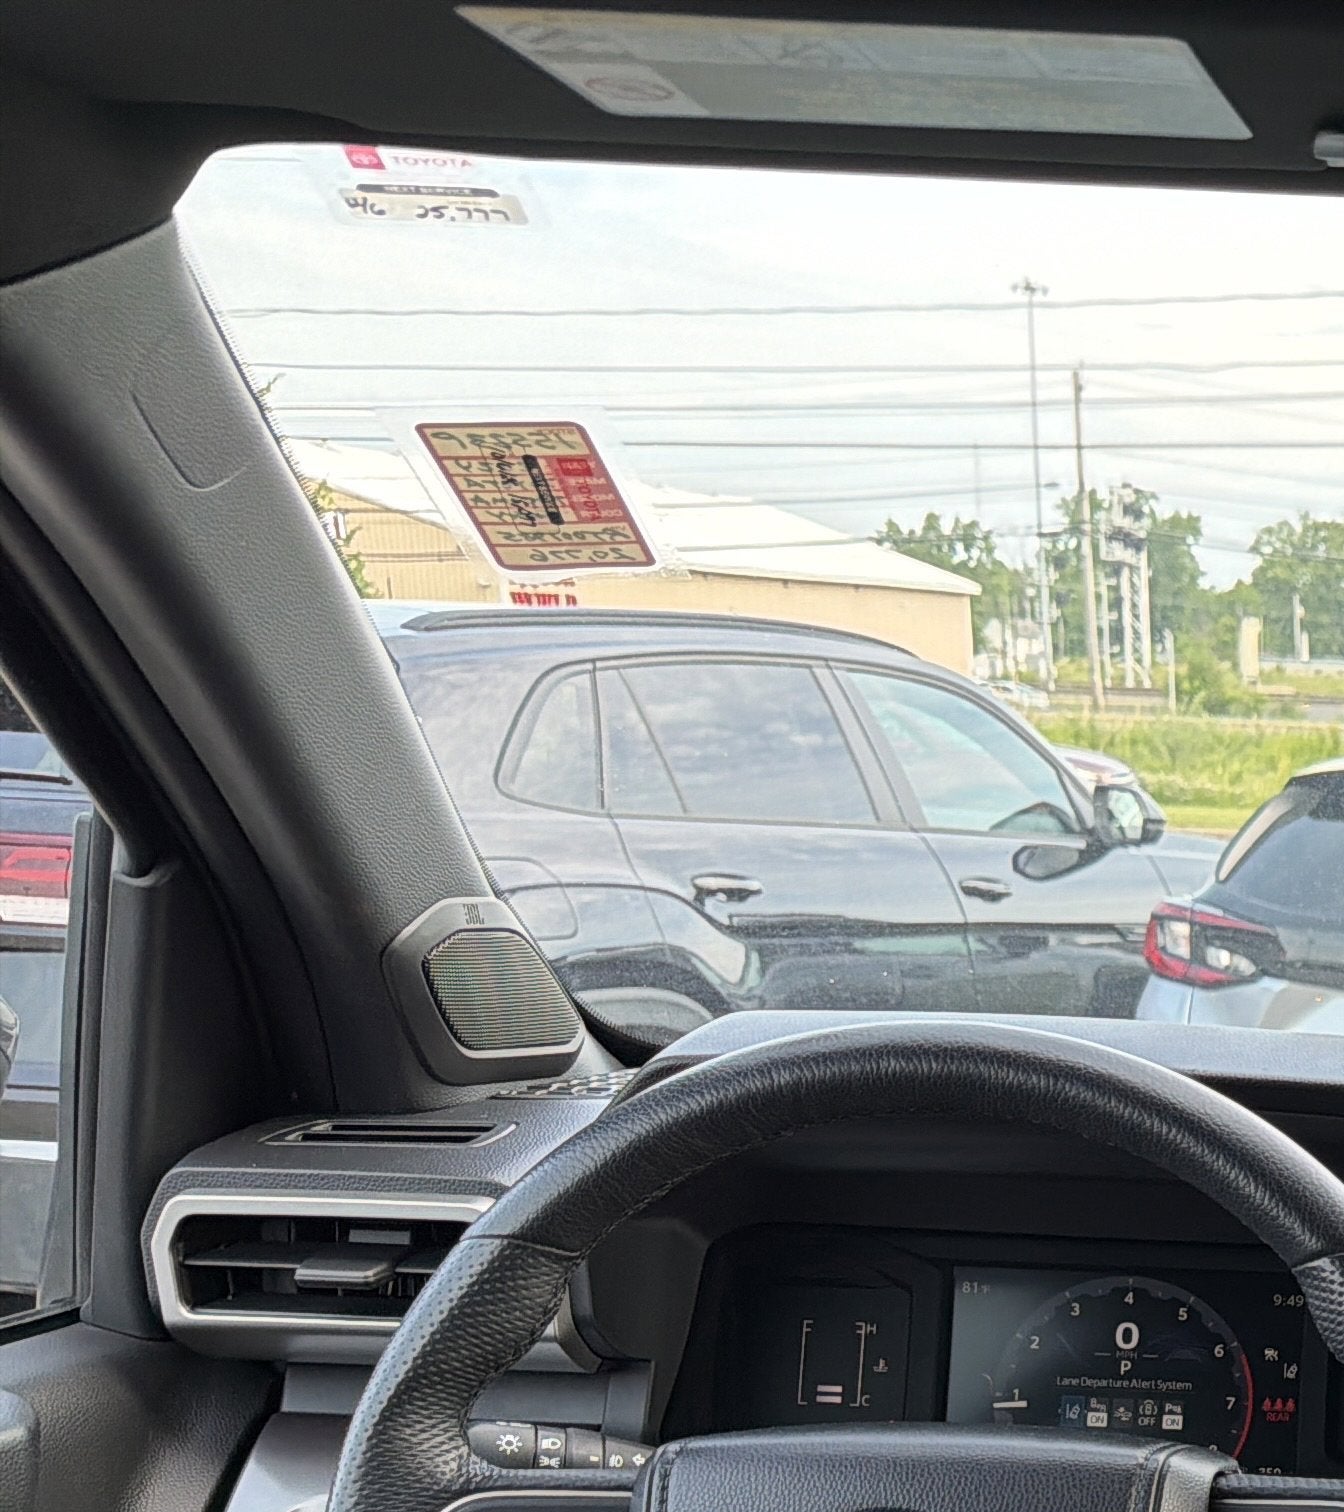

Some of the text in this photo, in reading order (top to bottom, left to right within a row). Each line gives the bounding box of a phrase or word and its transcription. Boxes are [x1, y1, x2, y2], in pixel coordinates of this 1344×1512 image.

[391, 155, 473, 168] TOYOTA
[1124, 1292, 1134, 1305] 4
[1273, 1294, 1304, 1307] 9:49
[1070, 1303, 1081, 1316] 3
[1178, 1308, 1188, 1321] 5
[866, 1322, 877, 1334] H
[1115, 1322, 1140, 1350] 0
[1030, 1336, 1040, 1350] 2
[1214, 1344, 1224, 1358] 6
[1120, 1361, 1132, 1375] P
[1056, 1376, 1193, 1391] Lane Departure Alert System
[861, 1394, 871, 1407] C
[1012, 1388, 1021, 1401] 1
[1226, 1397, 1236, 1410] 7
[1090, 1415, 1104, 1424] ON
[1138, 1417, 1156, 1426] OFF
[1165, 1418, 1180, 1427] ON
[1266, 1412, 1289, 1422] REAR
